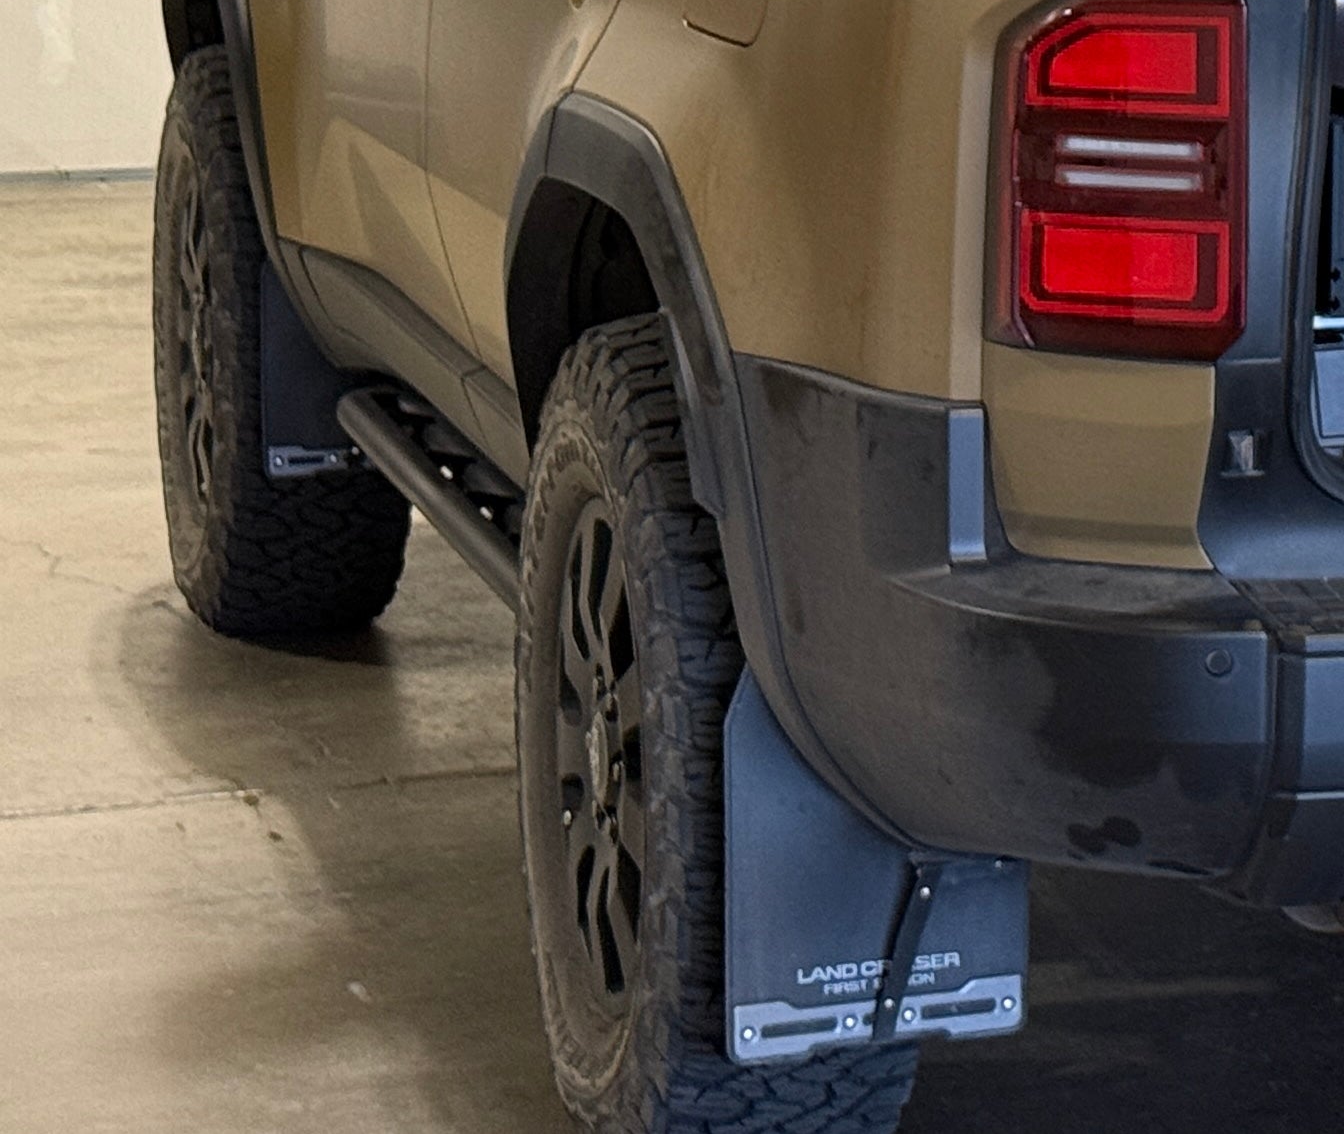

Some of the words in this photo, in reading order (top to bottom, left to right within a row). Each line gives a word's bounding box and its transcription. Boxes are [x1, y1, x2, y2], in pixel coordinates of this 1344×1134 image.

[796, 962, 859, 985] LAND
[860, 951, 961, 978] CRSER
[823, 979, 867, 996] FIRST
